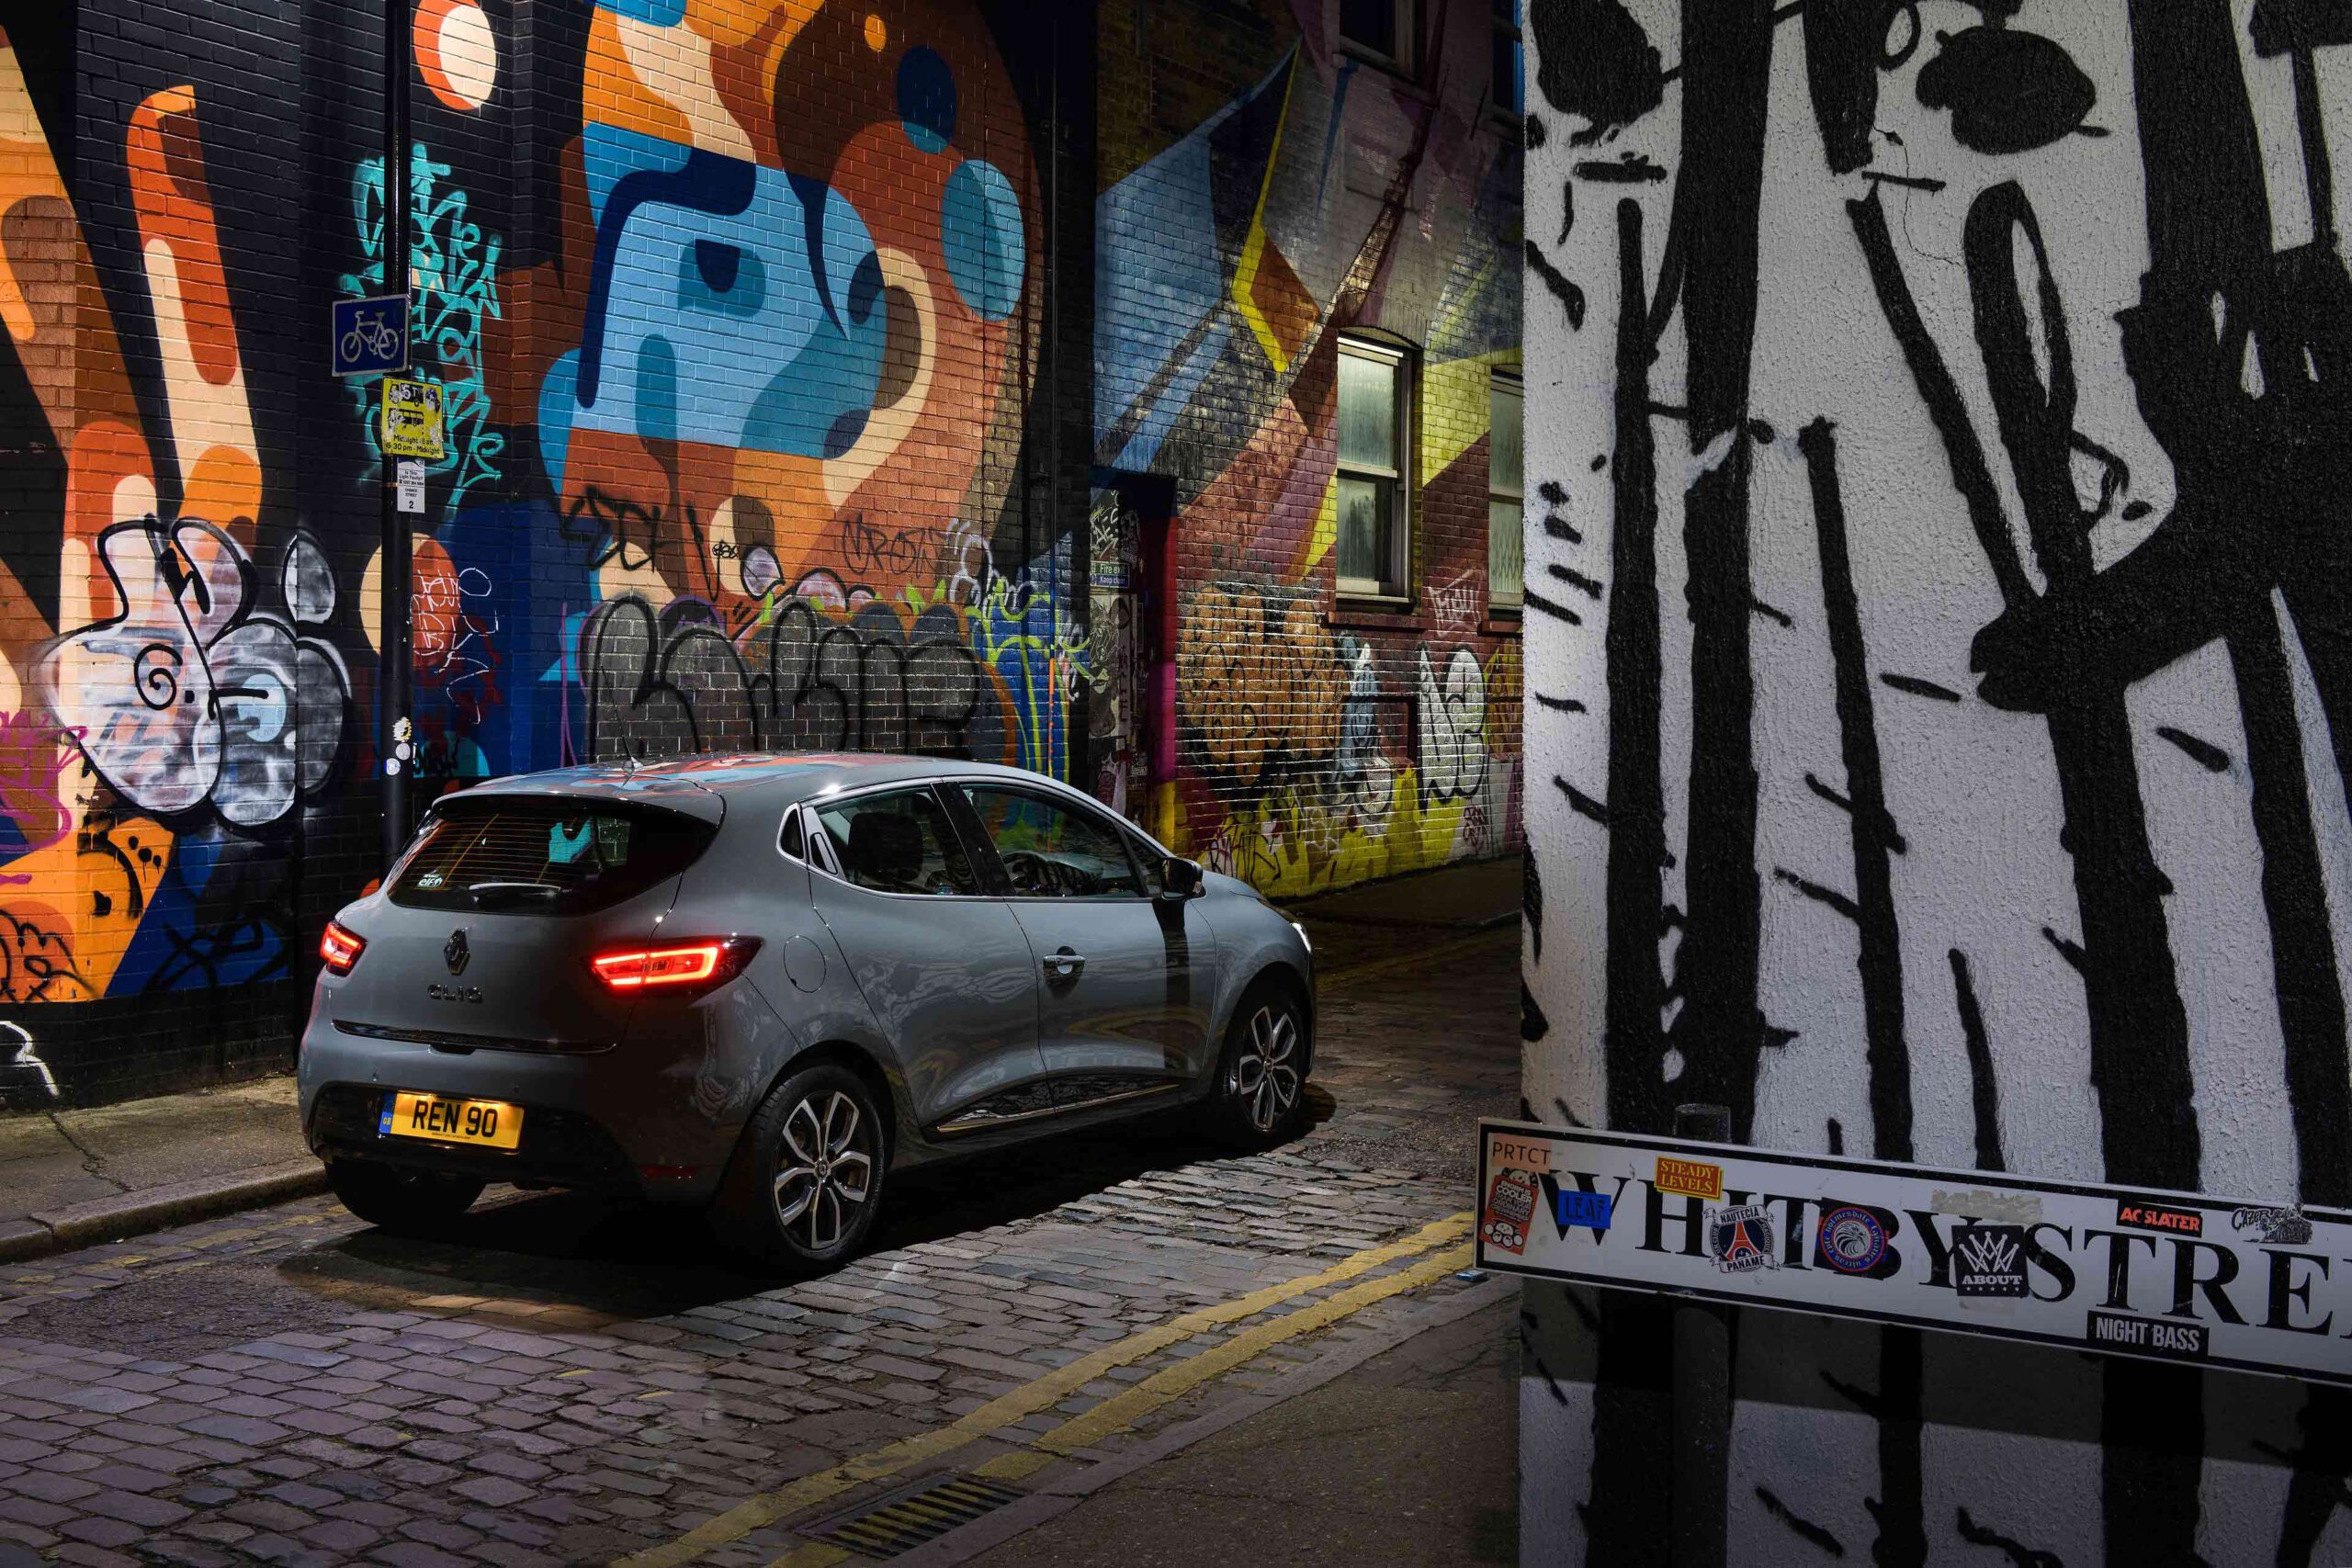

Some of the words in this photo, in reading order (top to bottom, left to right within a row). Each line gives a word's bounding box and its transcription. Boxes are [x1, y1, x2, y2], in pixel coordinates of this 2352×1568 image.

[409, 501, 414, 509] 2
[1100, 563, 1113, 574] Fire
[1100, 575, 1113, 584] Keep
[426, 984, 483, 1003] CLIO
[412, 1100, 460, 1134] REN
[465, 1106, 498, 1138] 90
[1492, 1142, 1552, 1166] PRTCT
[1660, 1160, 1714, 1179] STEADY
[1661, 1175, 1713, 1192] LEVELS
[1496, 1185, 1533, 1203] COOLER
[1565, 1196, 1606, 1222] LEAF
[1720, 1206, 1759, 1224] NAUTECIA
[2120, 1207, 2143, 1224] AC
[2143, 1210, 2200, 1232] SLATER
[1726, 1255, 1766, 1271] PANAME
[1962, 1275, 2023, 1285] ABOUT
[2024, 1223, 2352, 1339] STRE
[2096, 1316, 2148, 1345] NIGHT
[2152, 1325, 2200, 1352] BASS
